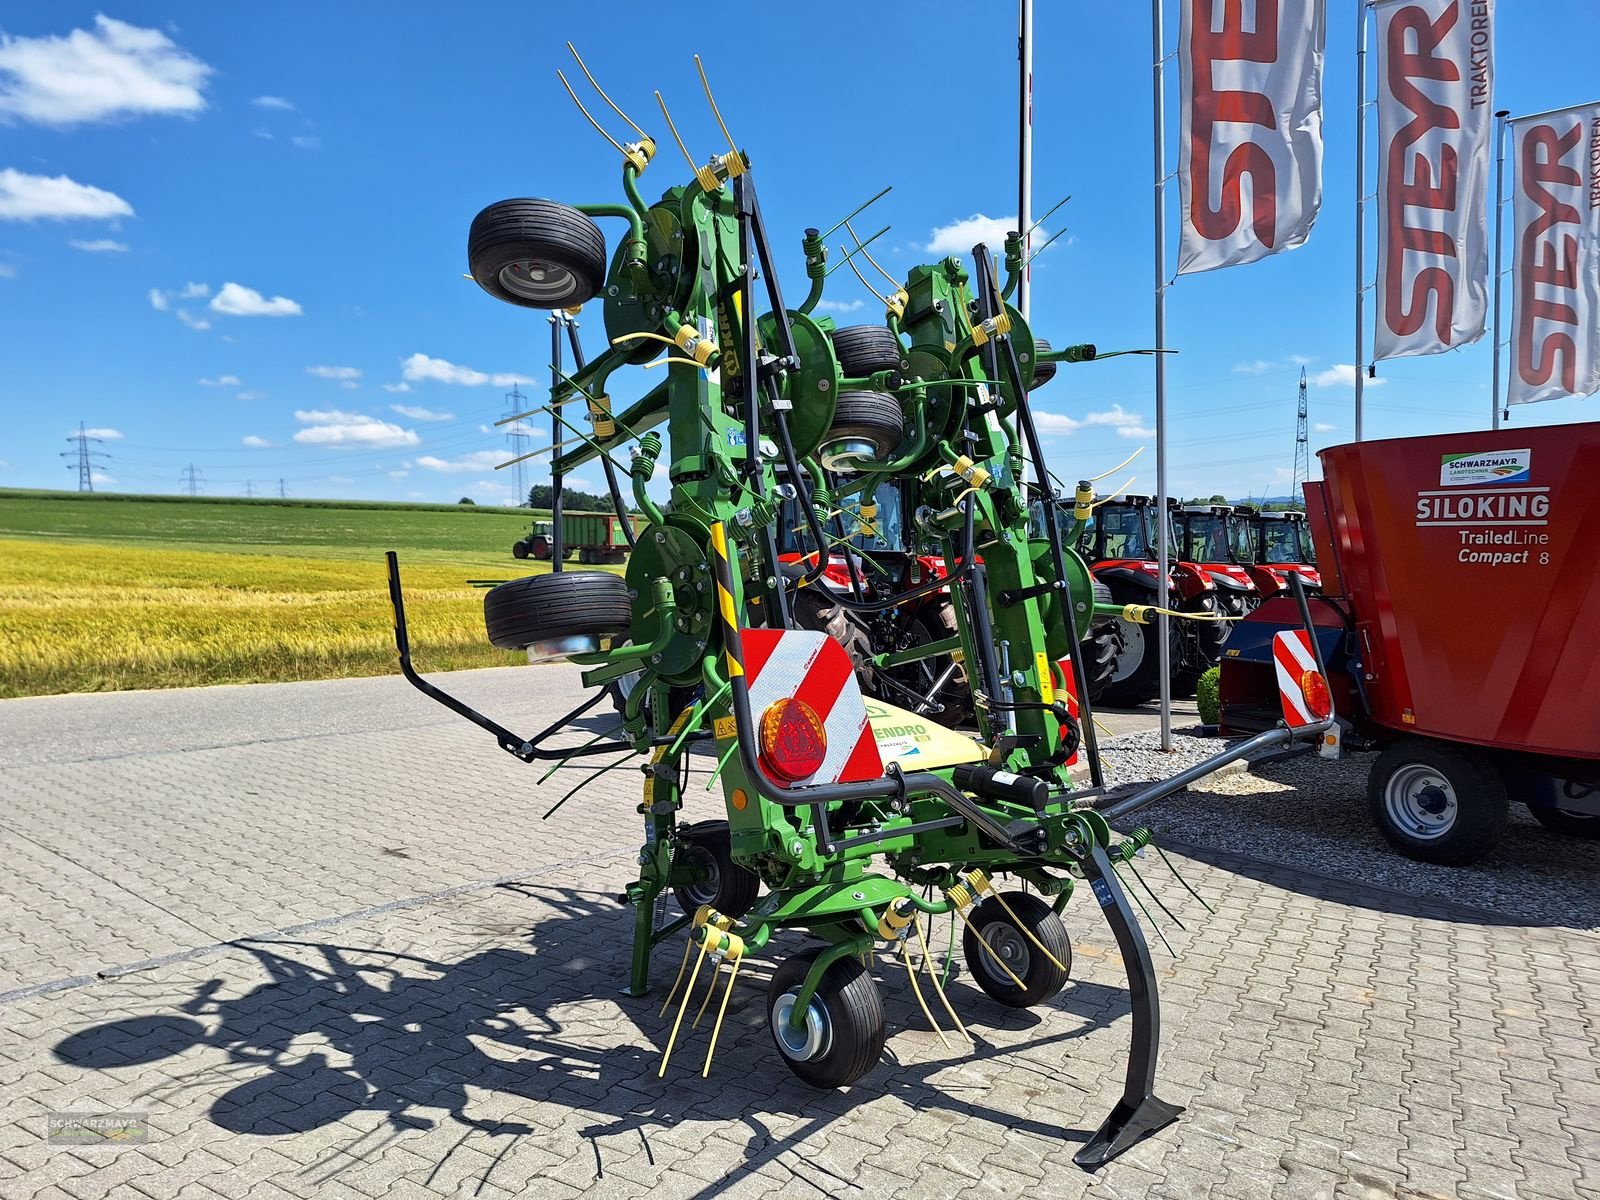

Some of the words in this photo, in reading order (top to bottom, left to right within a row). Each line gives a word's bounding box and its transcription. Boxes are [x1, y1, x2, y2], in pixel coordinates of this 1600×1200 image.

[1191, 0, 1277, 249] STE
[1385, 0, 1460, 346] STEYR
[1518, 121, 1582, 394] STEYR
[718, 302, 734, 347] KRO
[1449, 457, 1518, 469] SCHWARZMAYR
[1416, 495, 1550, 519] SILOKING
[1458, 529, 1549, 545] TrailedLine
[1458, 548, 1529, 567] Compact
[1539, 551, 1550, 565] 8
[873, 724, 927, 739] ENDRO
